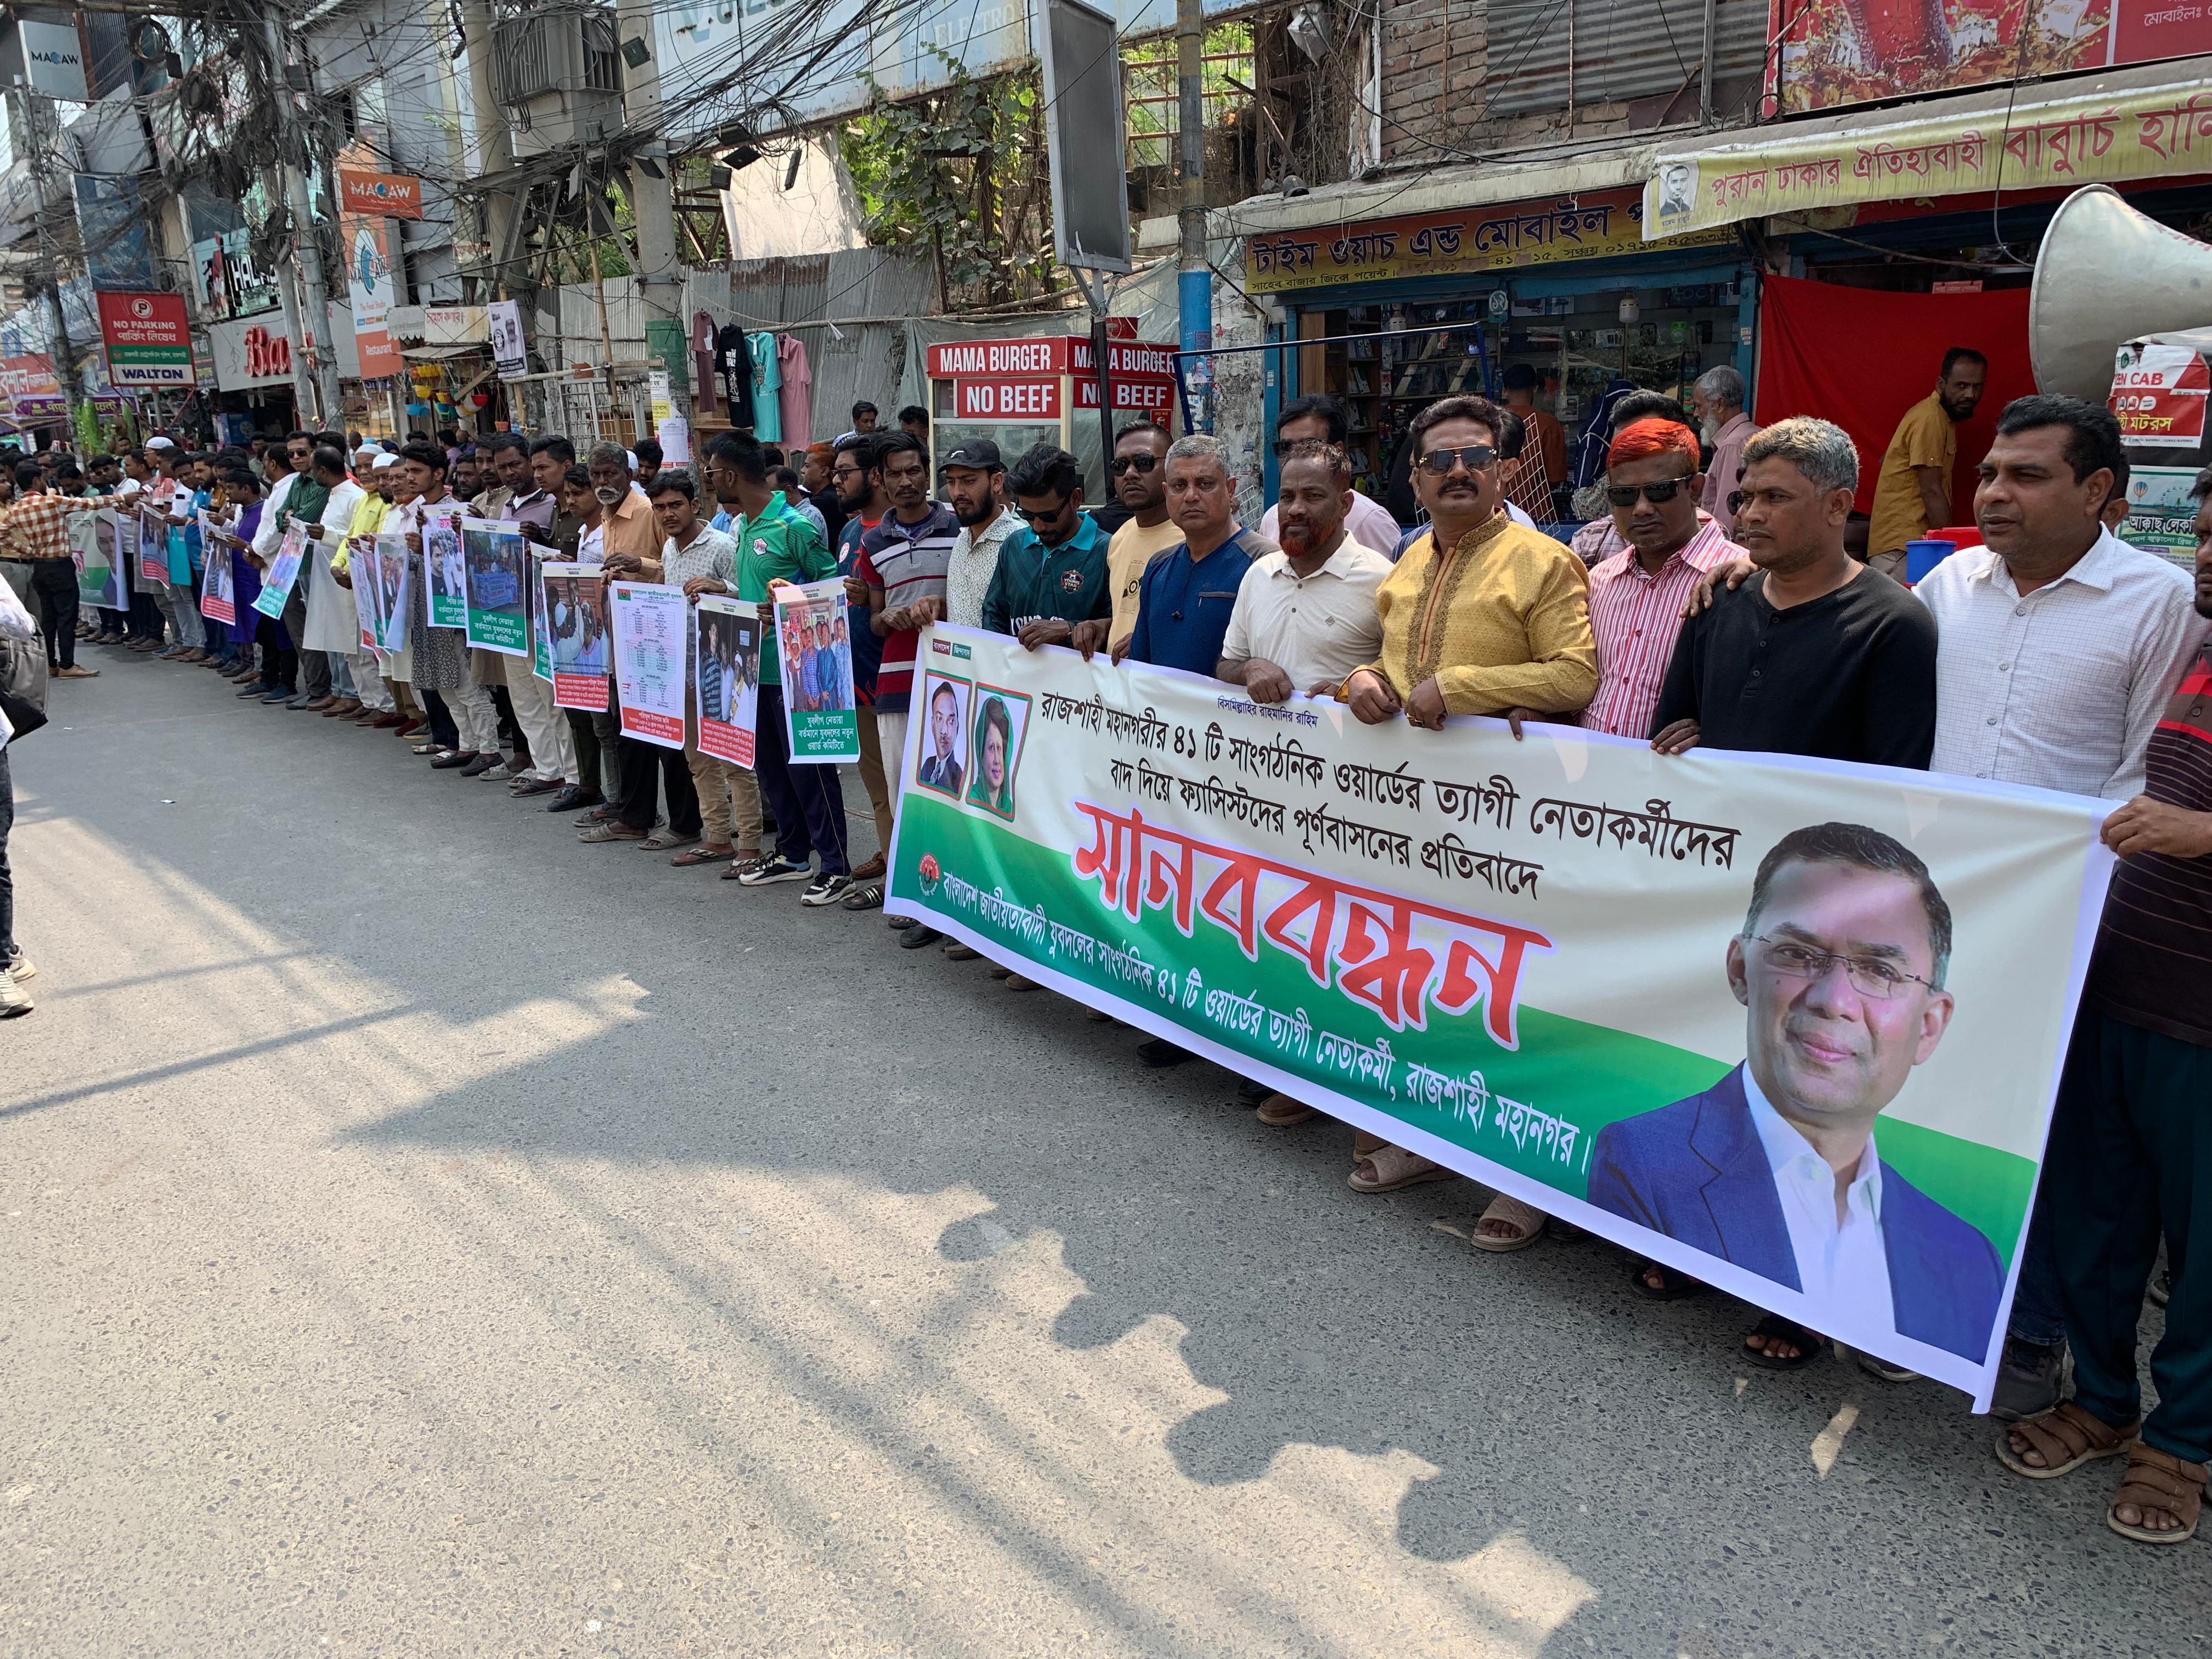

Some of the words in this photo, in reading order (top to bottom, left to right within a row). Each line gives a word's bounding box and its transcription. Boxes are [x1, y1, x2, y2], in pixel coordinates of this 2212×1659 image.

[1711, 169, 1768, 207] পুরান
[1774, 157, 1841, 191] ঢাকার
[1852, 131, 1987, 178] ঐতিহ্যবাহী
[1252, 235, 1319, 275] টাইম
[1327, 230, 1400, 266] ওয়াচ
[1410, 223, 1466, 258] এন্ড
[1475, 200, 1616, 253] মোবাইল
[1285, 276, 1317, 288] বাজার
[113, 320, 128, 329] NO
[131, 321, 176, 329] PARKING
[117, 330, 145, 341] পার্কিং
[147, 330, 176, 341] নিষেধ
[365, 343, 392, 356] Restaurant
[940, 347, 986, 373] MAMA
[989, 344, 1051, 372] BURGER
[1074, 345, 1119, 370] MAA
[122, 369, 183, 379] WALTON
[2130, 373, 2164, 386] CAB
[967, 386, 994, 413] NO
[1000, 385, 1054, 413] BEEF
[1117, 384, 1167, 407] BEEF
[2131, 413, 2174, 431] মটরস
[806, 714, 824, 728] যুবলীগ
[826, 715, 843, 725] নেতারা
[1217, 695, 1257, 717] বিসমিল্লাহির
[1259, 706, 1294, 723] রাহমানির
[1295, 710, 1319, 729] রাহিম
[798, 727, 819, 738] বর্তমানে
[819, 729, 840, 740] যুবদলের
[841, 728, 854, 740] নতুন
[822, 738, 845, 750] কমিটিতে
[1042, 691, 1104, 737] রাজশাহী
[1105, 706, 1170, 752] মহানগরীর
[1173, 727, 1197, 758] ৪১
[1204, 722, 1224, 763] টি
[1229, 732, 1326, 789] সাংগঠনিক
[1334, 761, 1426, 813] ওয়ার্ডের
[1432, 774, 1520, 830] ত্যাগী
[1530, 799, 1742, 870] নেতাকর্মীদের
[1111, 757, 1134, 793] বাদ
[1138, 758, 1173, 805] দিয়ে
[1180, 777, 1285, 835] ফ্যাসিস্টদের
[1294, 803, 1414, 869] পূর্ণবাসনের
[1420, 833, 1544, 900] প্রতিবাদে
[1074, 800, 1554, 1045] মানববন্ধন
[943, 871, 978, 915] বাংলাদেশ
[979, 886, 1047, 946] জাতীয়তাবাদী
[1049, 919, 1095, 967] যুবদলের
[1098, 939, 1154, 994] সাংগঠনিক
[1156, 968, 1177, 1005] ৪১
[1181, 966, 1203, 1010] টি
[1205, 989, 1265, 1040] ওয়ার্ডের
[1268, 1007, 1313, 1059] ত্যাগী
[1316, 1037, 1398, 1102] নেতাকর্মী,
[1406, 1062, 1491, 1135] রাজশাহী
